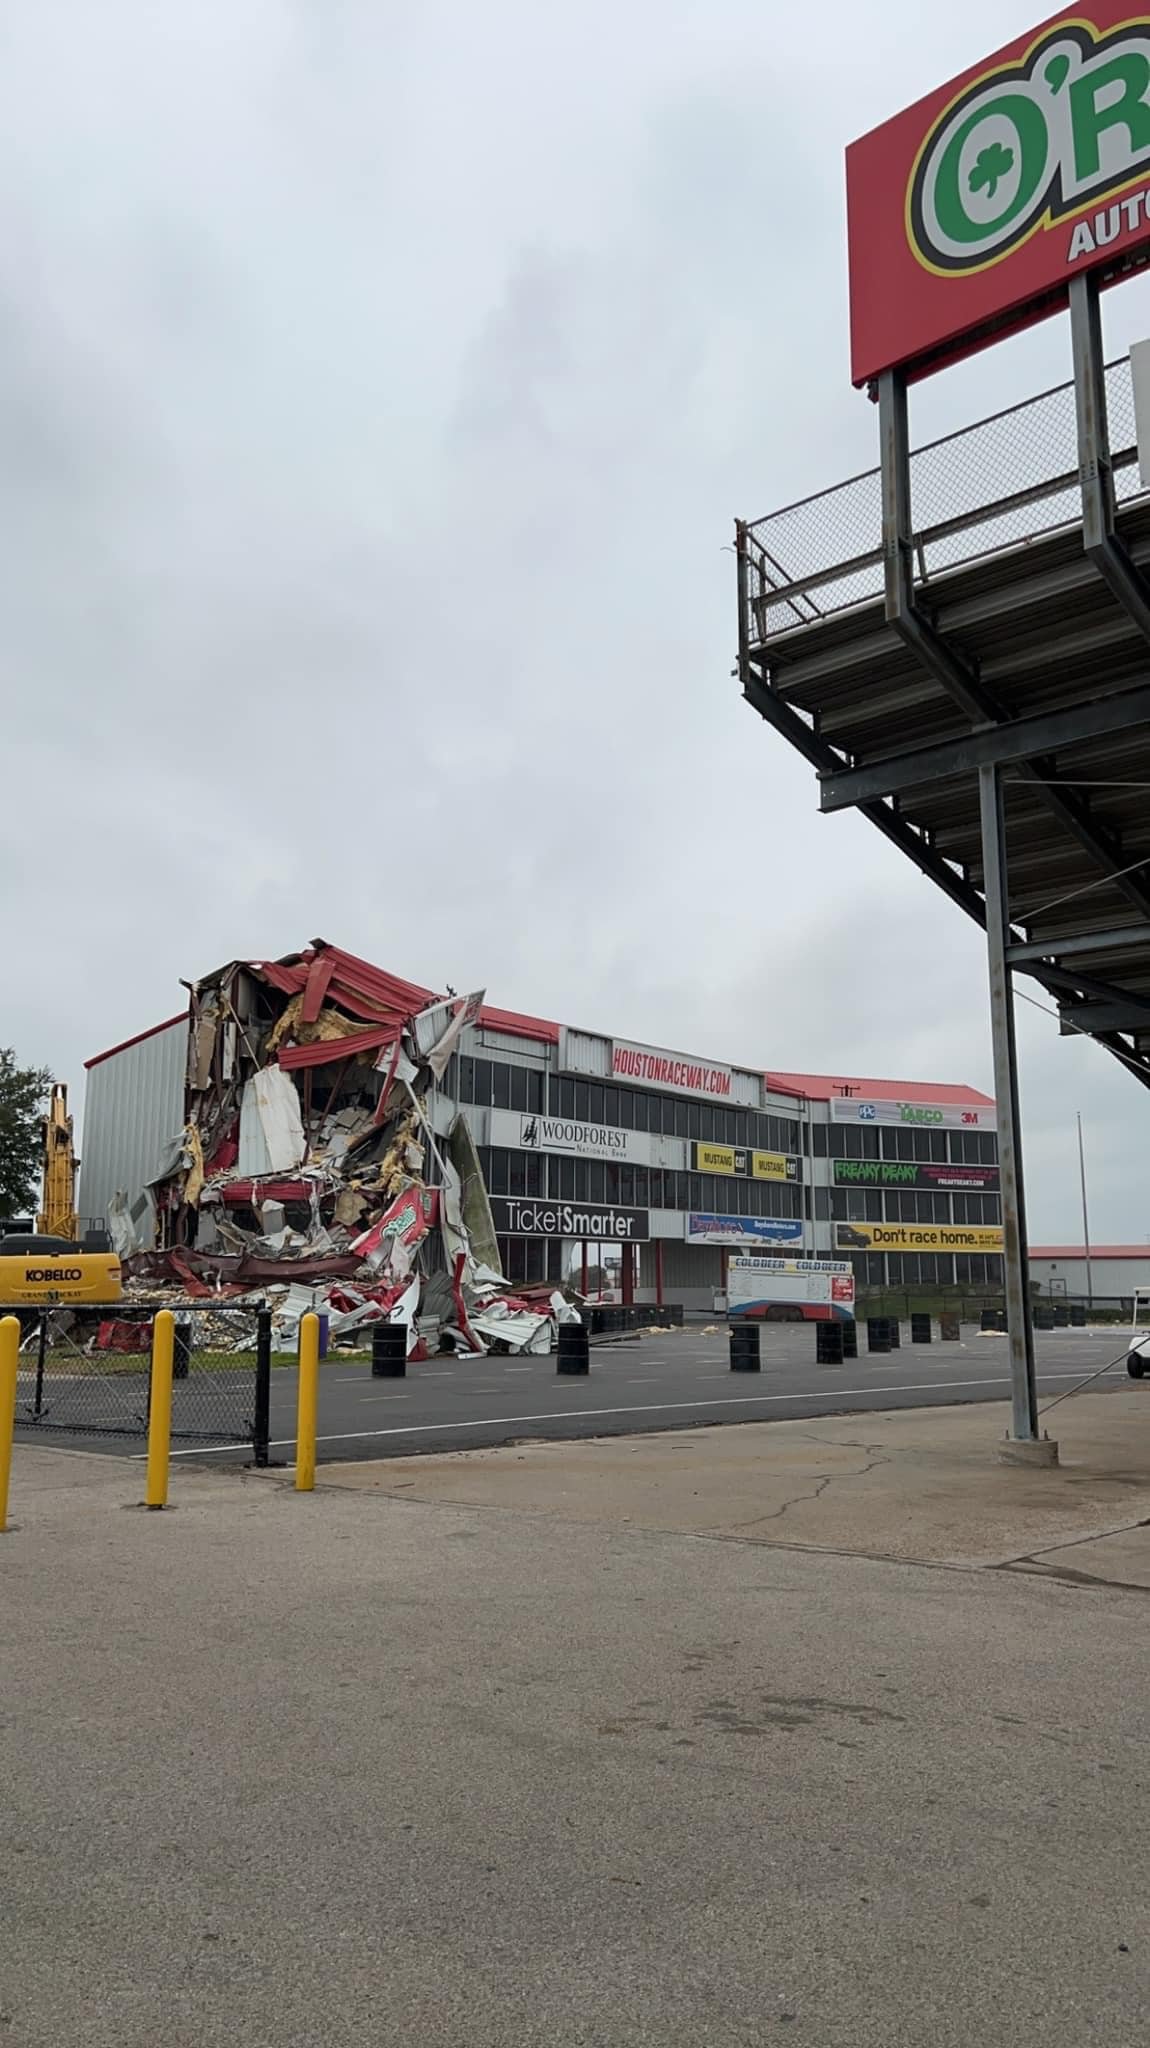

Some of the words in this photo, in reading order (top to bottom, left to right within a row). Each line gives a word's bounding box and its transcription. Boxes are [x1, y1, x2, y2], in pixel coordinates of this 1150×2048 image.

[1067, 189, 1150, 263] AUT
[613, 1047, 731, 1095] HOUSTONRACEWAY.COM
[859, 1104, 876, 1120] PPG
[961, 1111, 978, 1124] 3M
[542, 1120, 628, 1149] WOODFOREST
[704, 1152, 732, 1167] MUSTANG
[758, 1159, 784, 1173] MUSTANG
[835, 1162, 880, 1184] FREAKY
[881, 1164, 918, 1184] DEAKY
[506, 1202, 634, 1237] TicketSmarter
[873, 1228, 908, 1242] Don't
[909, 1231, 937, 1243] race
[940, 1229, 978, 1245] home.
[735, 1257, 760, 1268] COLD
[760, 1258, 785, 1269] BEER
[796, 1260, 821, 1271] COLD
[821, 1262, 847, 1272] BEER
[25, 1268, 82, 1282] KOBELCO
